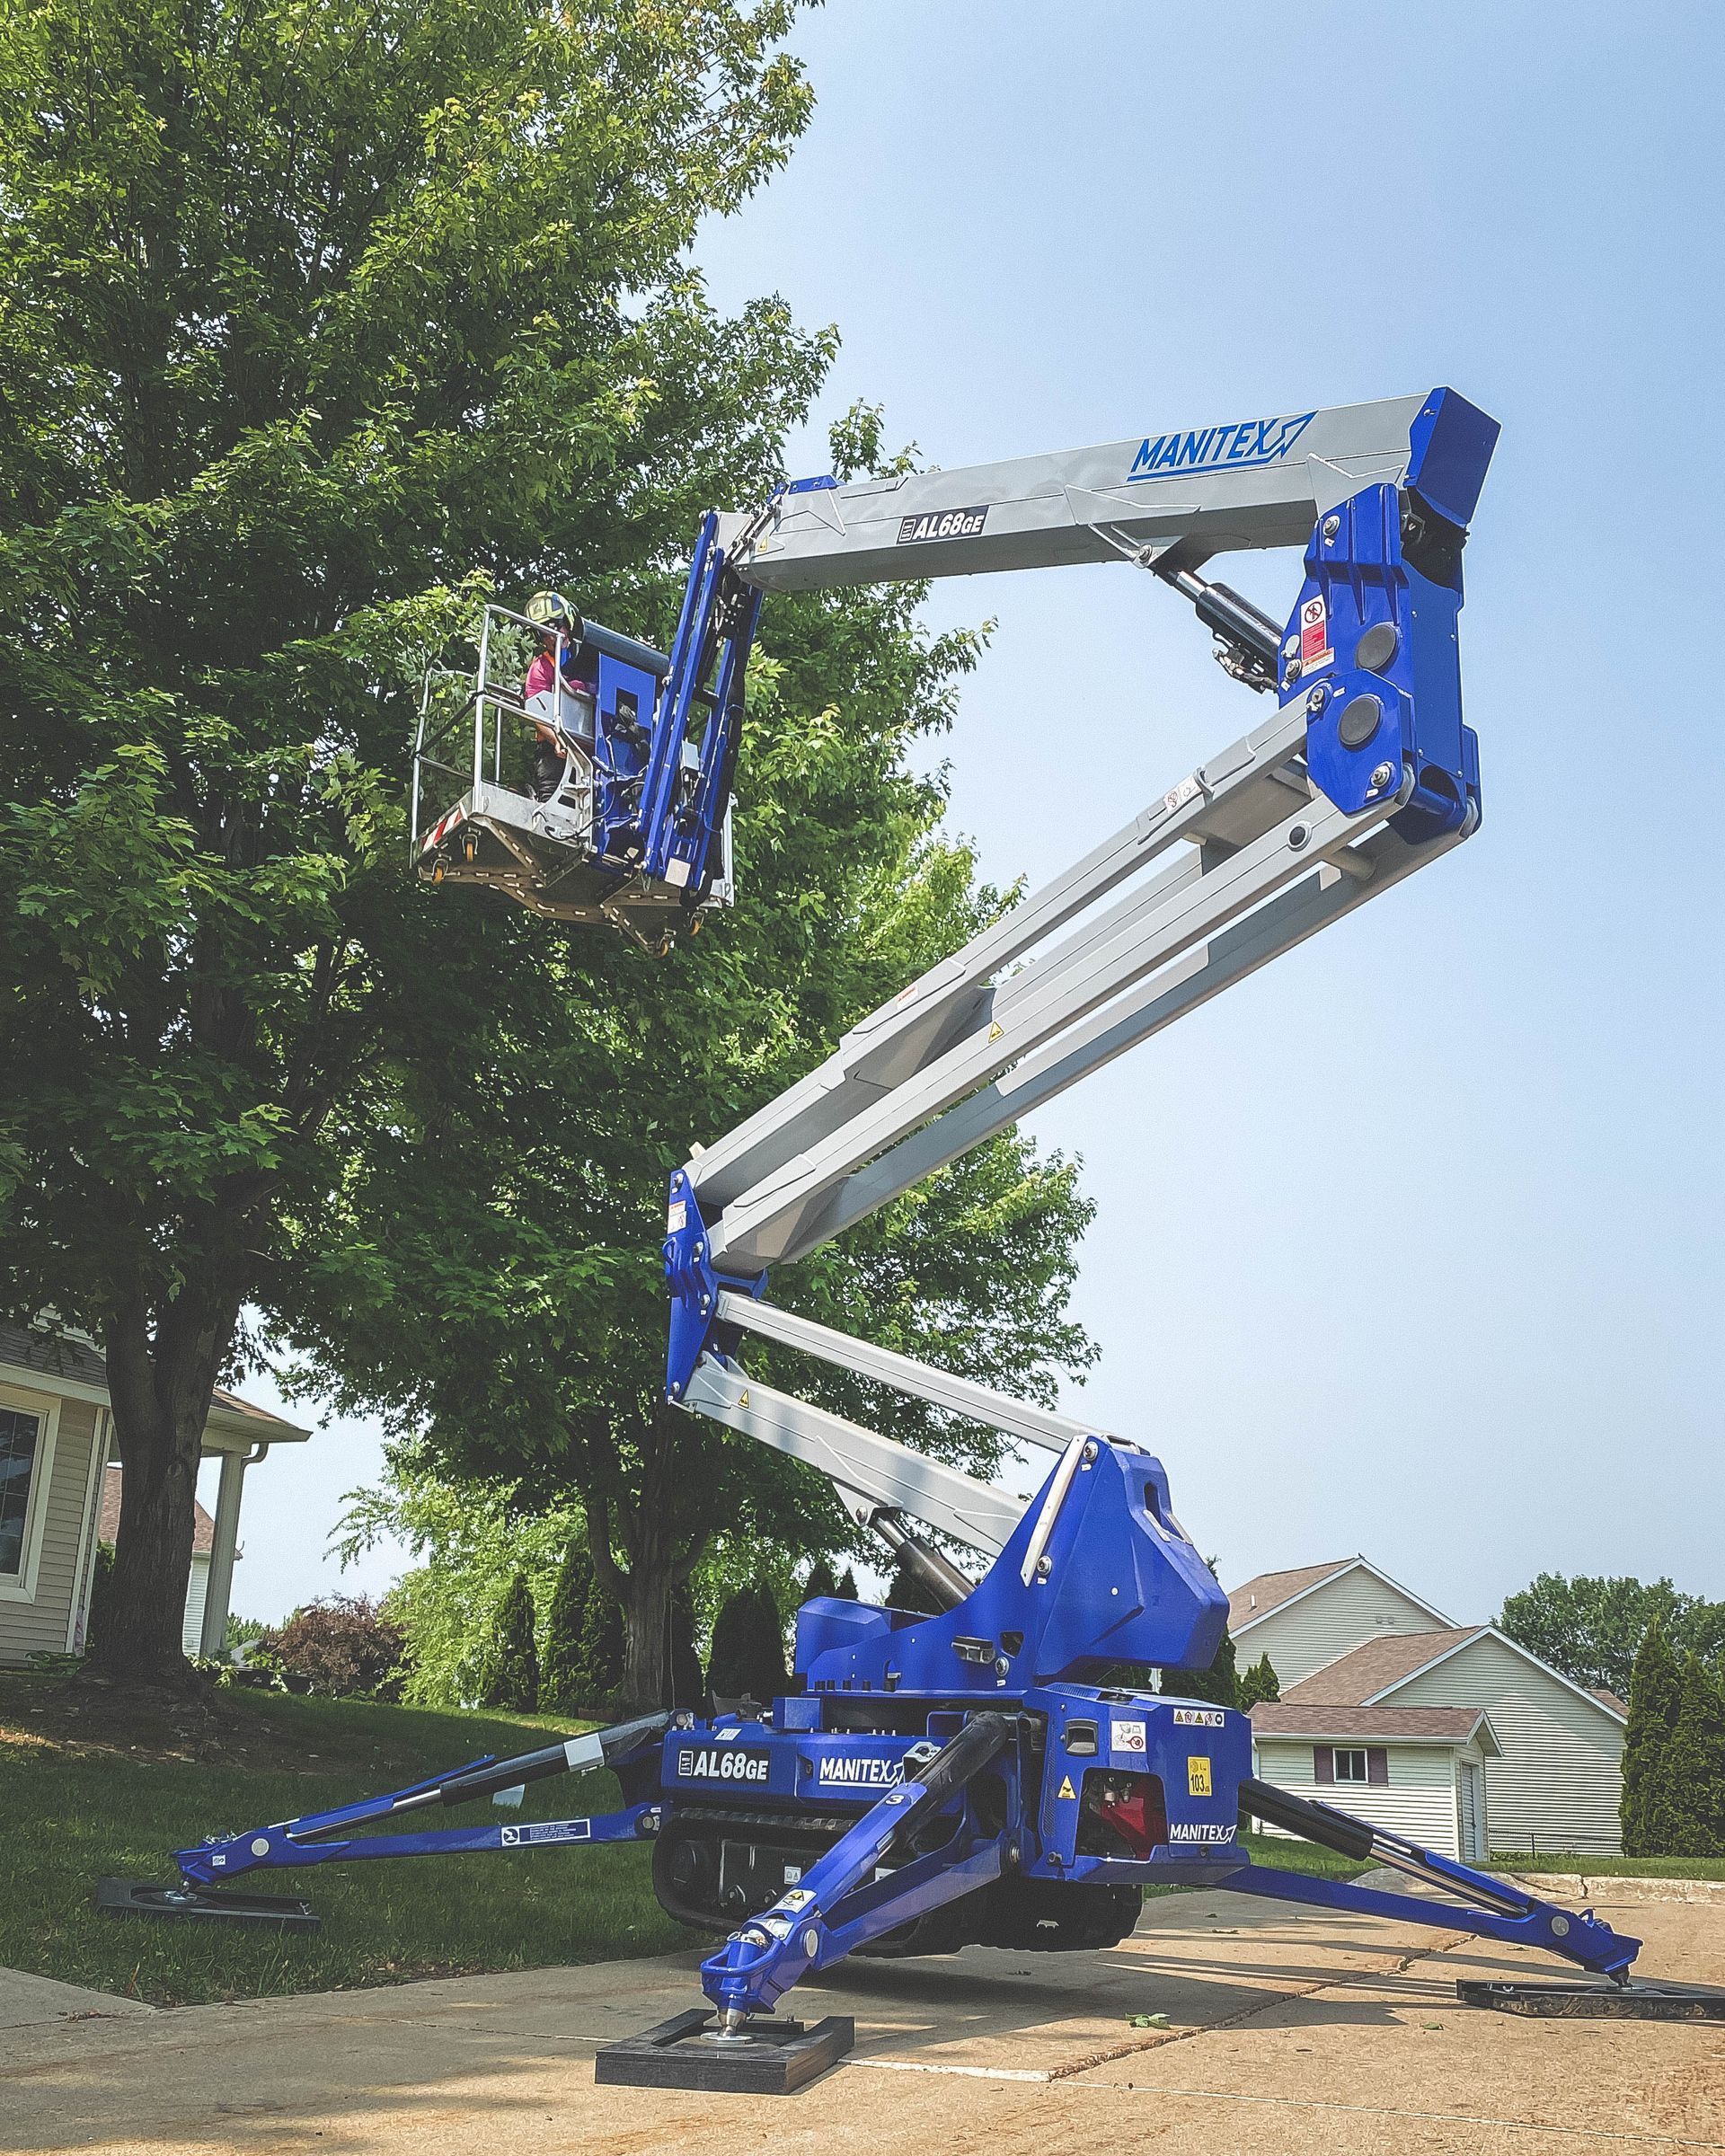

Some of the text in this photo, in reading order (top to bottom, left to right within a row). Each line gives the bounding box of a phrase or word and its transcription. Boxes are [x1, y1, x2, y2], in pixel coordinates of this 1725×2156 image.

[1130, 418, 1279, 473] MANITEX
[913, 512, 985, 540] AL68GE
[693, 1751, 769, 1780] AL68GE
[819, 1757, 892, 1782] MANITEX
[1190, 1773, 1205, 1792] 103
[885, 1794, 905, 1805] 3
[1170, 1824, 1225, 1841] MANITEX
